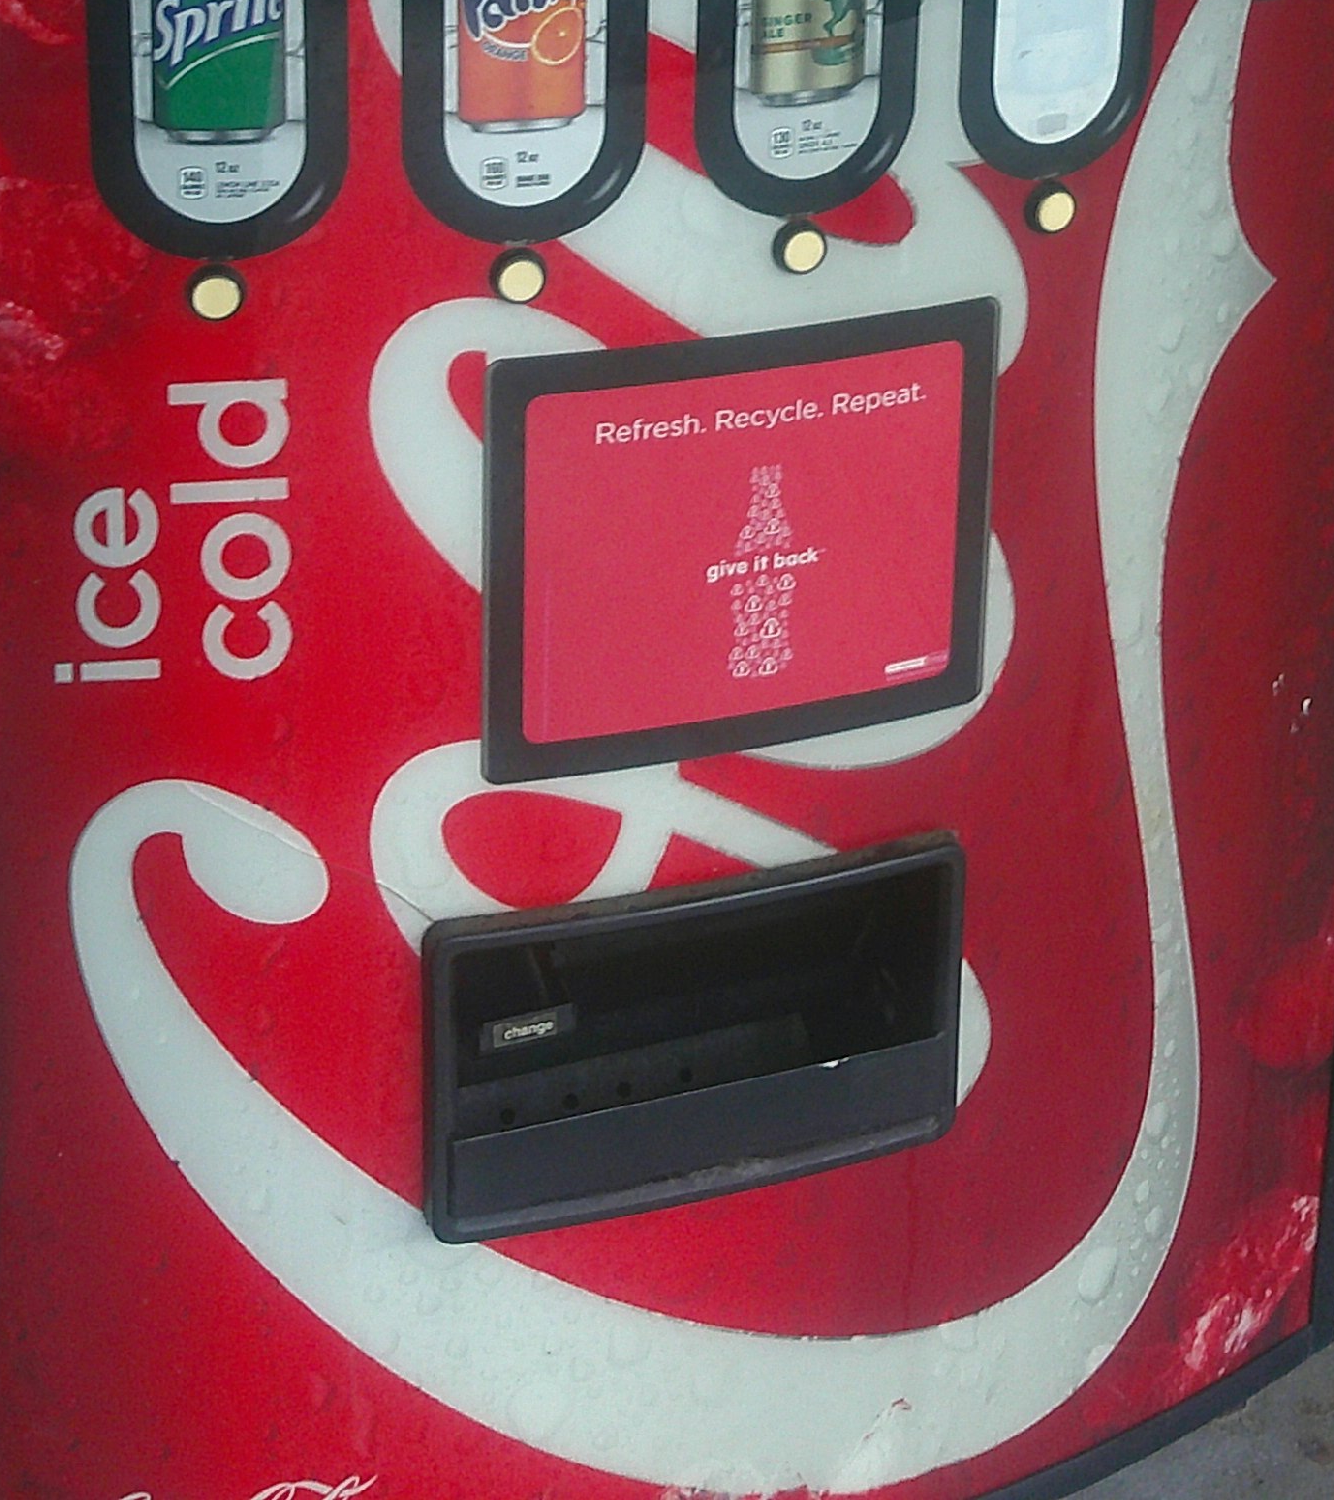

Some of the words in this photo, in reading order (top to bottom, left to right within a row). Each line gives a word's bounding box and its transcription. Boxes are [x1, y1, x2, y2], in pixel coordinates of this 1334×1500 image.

[595, 413, 707, 445] Refresh.
[715, 399, 824, 431] Recycle.
[832, 382, 927, 415] Repeat.
[168, 378, 293, 680] cold
[54, 487, 161, 684] ice
[707, 560, 749, 583] give
[753, 555, 769, 573] it
[773, 547, 818, 569] back
[504, 1021, 554, 1040] change
